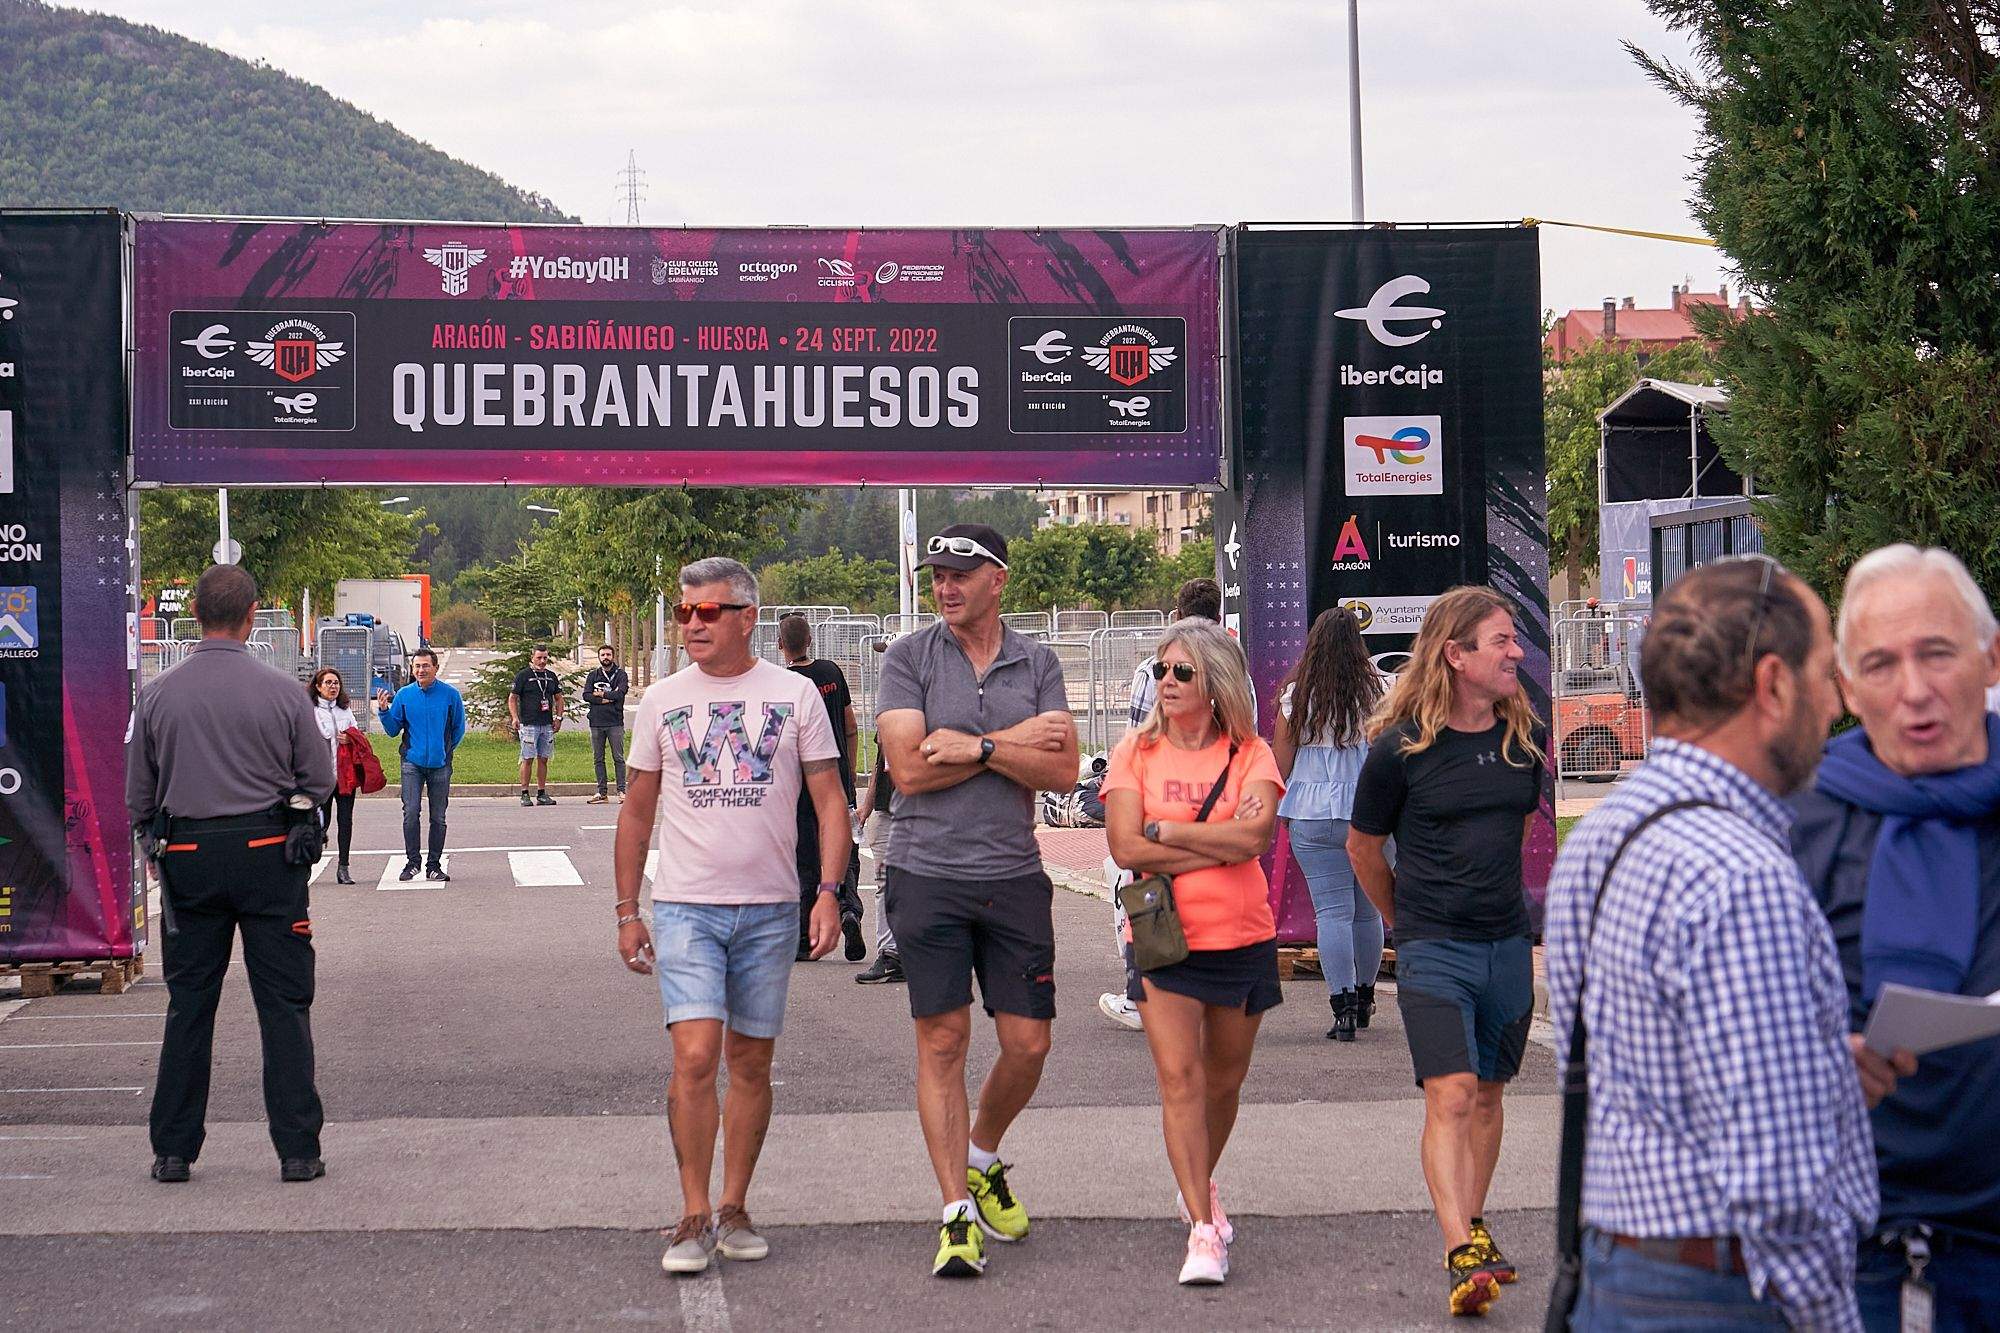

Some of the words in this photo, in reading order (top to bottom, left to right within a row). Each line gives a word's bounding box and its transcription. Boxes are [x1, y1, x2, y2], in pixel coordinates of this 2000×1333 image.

[509, 256, 629, 284] #YoSoyQH
[689, 260, 718, 268] CICLISTA
[739, 261, 798, 280] octagon
[668, 267, 719, 276] EDELWEISS
[441, 270, 468, 297] 365
[818, 279, 855, 287] CICLISMO
[263, 318, 328, 342] QUEBRANTAHUESOS
[288, 332, 303, 340] 2022
[432, 319, 506, 350] ARAGÓN
[530, 319, 675, 351] SABIÑÁNIGO
[698, 326, 769, 351] HUESCA
[795, 328, 823, 352] 24
[832, 328, 882, 352] SEPT.
[889, 328, 938, 352] 2022
[1100, 324, 1159, 347] QUEBRANTAHUESOS
[1122, 337, 1136, 345] 2022
[182, 366, 235, 380] iberCaja
[1021, 371, 1072, 385] iberCaja
[1340, 364, 1443, 390] iberCaja
[393, 362, 979, 432] QUEBRANTAHUESOS
[274, 416, 318, 425] TotalEnergies
[1109, 419, 1151, 427] TotalEnergies
[1355, 472, 1432, 484] TotalEnergies
[1387, 531, 1461, 548] turismo
[1332, 560, 1371, 571] ARAGÓN
[1375, 605, 1428, 615] Ayuntami
[662, 701, 794, 787] W
[687, 787, 767, 800] SOMEWHERE
[692, 798, 719, 808] OUT
[721, 797, 762, 807] THERE
